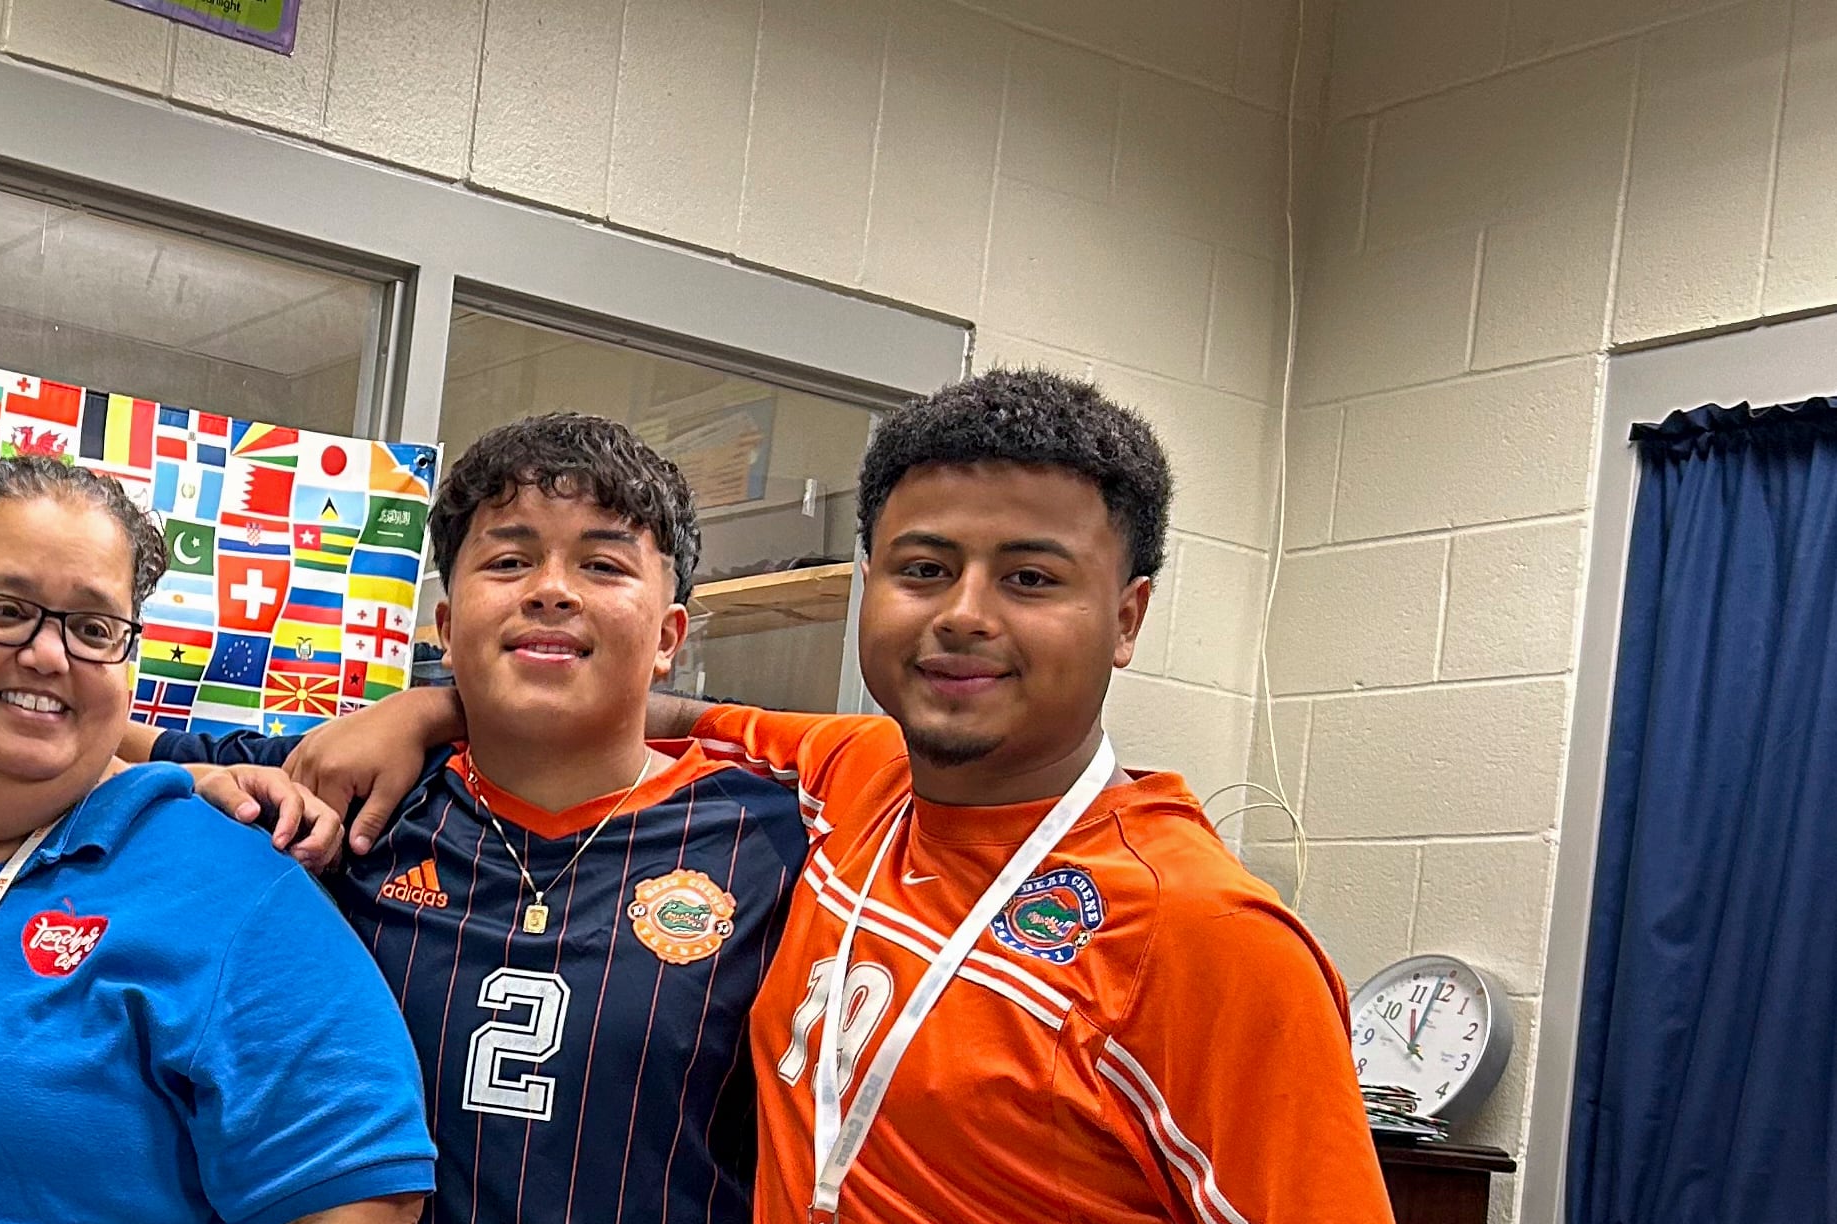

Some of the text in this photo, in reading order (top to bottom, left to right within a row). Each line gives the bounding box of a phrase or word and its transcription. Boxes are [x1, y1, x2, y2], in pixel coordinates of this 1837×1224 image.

[381, 883, 449, 909] adidas
[1022, 873, 1100, 923] BEAU CHENE
[1409, 984, 1428, 1005] 11
[1434, 982, 1455, 1003] 12
[1382, 1000, 1403, 1021] 10
[1457, 996, 1471, 1016] 1
[1360, 1027, 1376, 1046] 9
[1462, 1021, 1479, 1041] 2
[462, 966, 571, 1121] 2
[1355, 1057, 1368, 1077] 8
[1454, 1052, 1471, 1072] 3
[1434, 1080, 1451, 1100] 4
